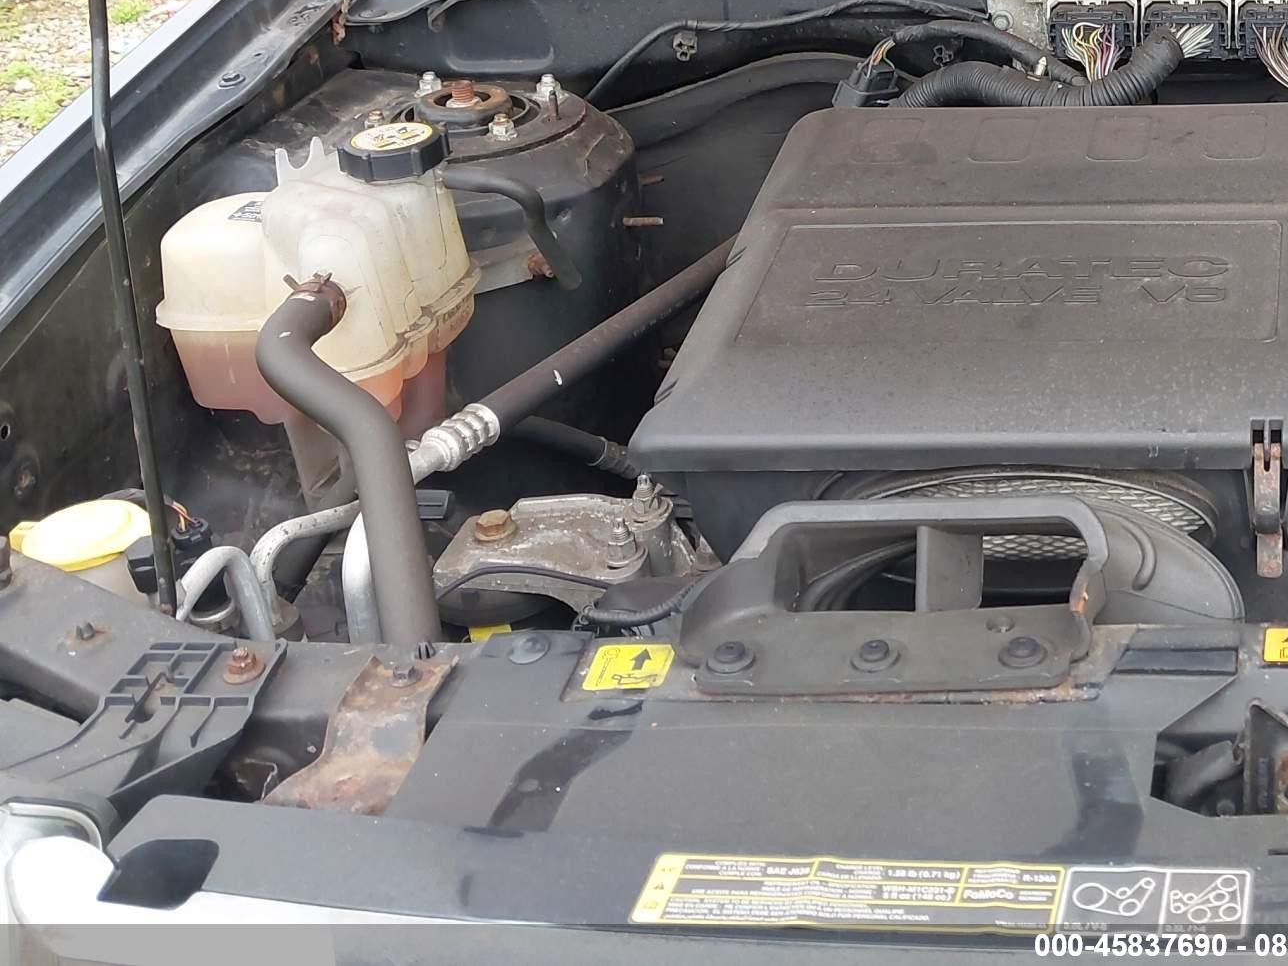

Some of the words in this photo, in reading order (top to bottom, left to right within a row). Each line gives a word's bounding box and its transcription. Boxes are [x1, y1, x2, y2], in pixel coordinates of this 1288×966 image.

[815, 258, 1229, 282] DURATEC
[805, 287, 893, 307] 24
[914, 285, 1101, 306] VALVE
[963, 888, 1014, 900] FoMoCo
